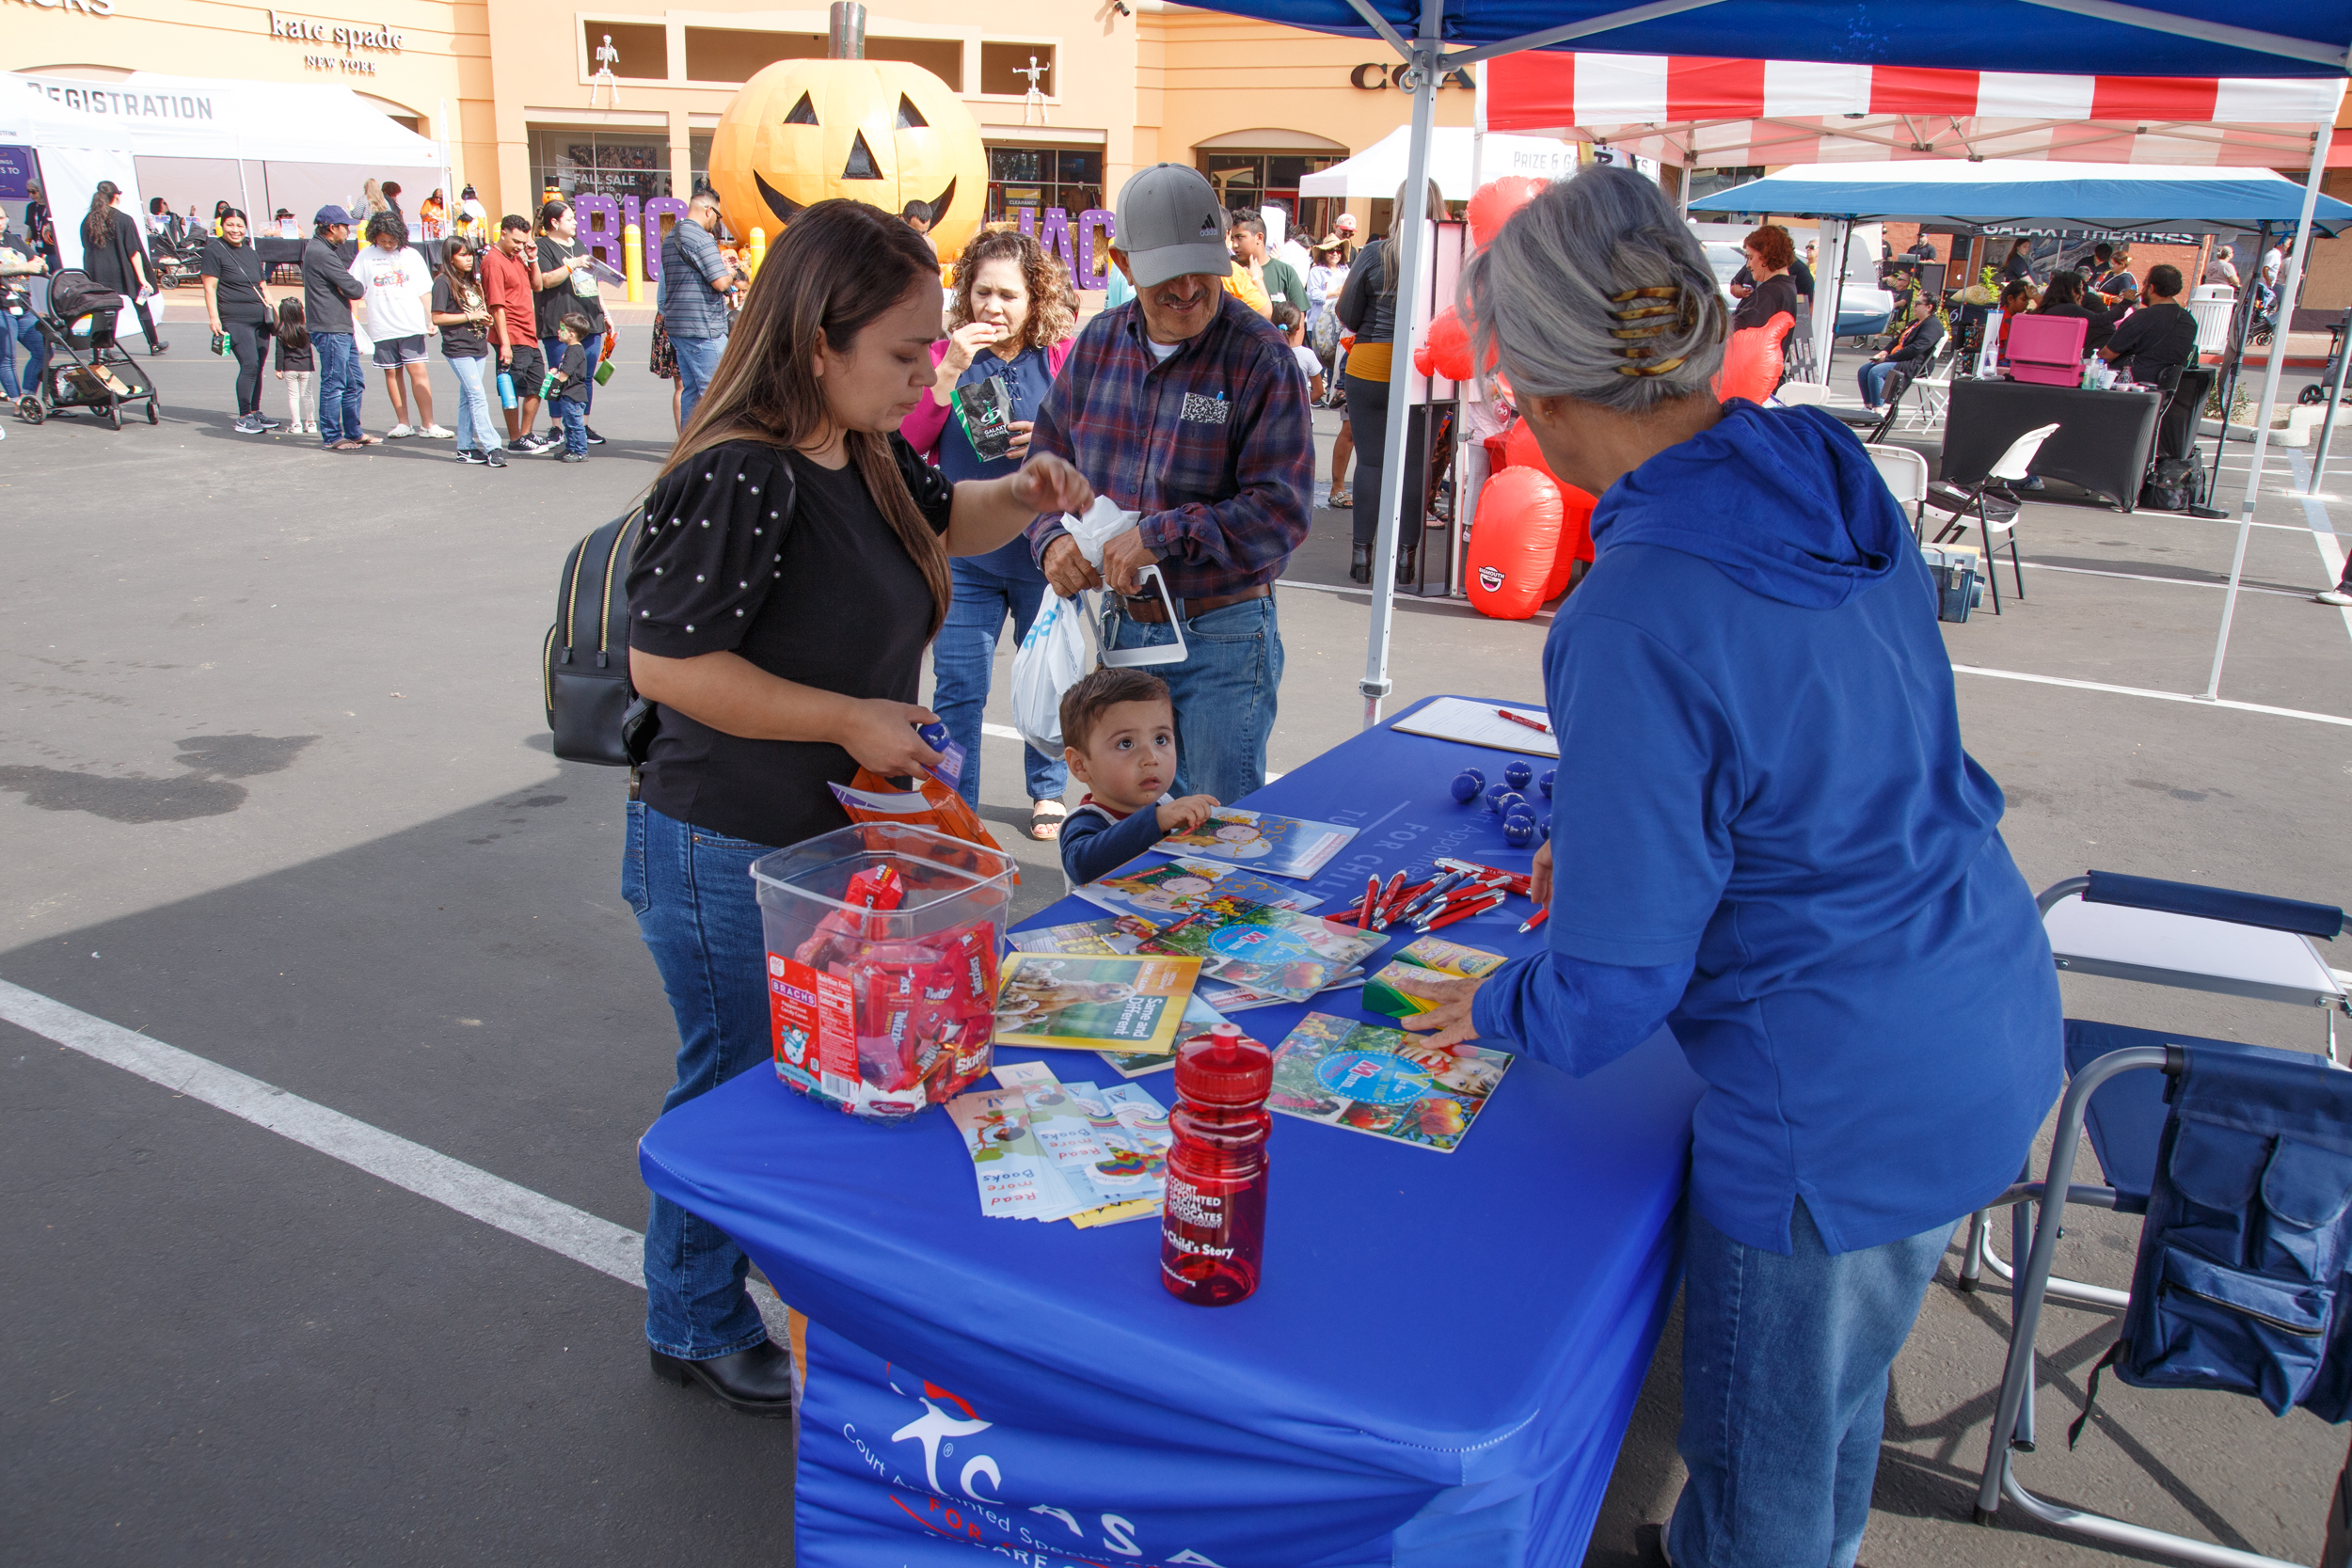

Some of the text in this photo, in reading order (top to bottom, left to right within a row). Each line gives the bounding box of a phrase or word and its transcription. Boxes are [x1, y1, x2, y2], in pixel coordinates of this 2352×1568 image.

[268, 8, 405, 52] kate spade
[305, 55, 377, 71] NEW YORK
[1513, 150, 1547, 169] PRIZE
[573, 173, 636, 186] FALL SALE
[984, 423, 1007, 435] GALAXY
[1373, 822, 1429, 849] FOR
[1143, 963, 1155, 975] LOOK
[1136, 977, 1149, 993] LEARN
[1113, 997, 1145, 1036] Different
[1132, 997, 1163, 1037] Same and
[1394, 1071, 1434, 1090] Y
[1041, 1129, 1090, 1140] Books
[1049, 1137, 1091, 1148] more
[1058, 1148, 1101, 1160] Read
[983, 1169, 1034, 1182] Books
[1091, 1175, 1134, 1183] adventure
[987, 1180, 1033, 1191] more
[1169, 1175, 1198, 1194] COURT
[992, 1192, 1036, 1206] Read
[1169, 1184, 1221, 1207] APPOINTED
[1169, 1191, 1202, 1212] SPECIAL
[1168, 1199, 1222, 1222] ADVOCATES
[1194, 1219, 1222, 1228] COUNTY
[1168, 1230, 1234, 1259] Child's Story
[843, 1423, 885, 1477] Court
[928, 1497, 983, 1542] FOR
